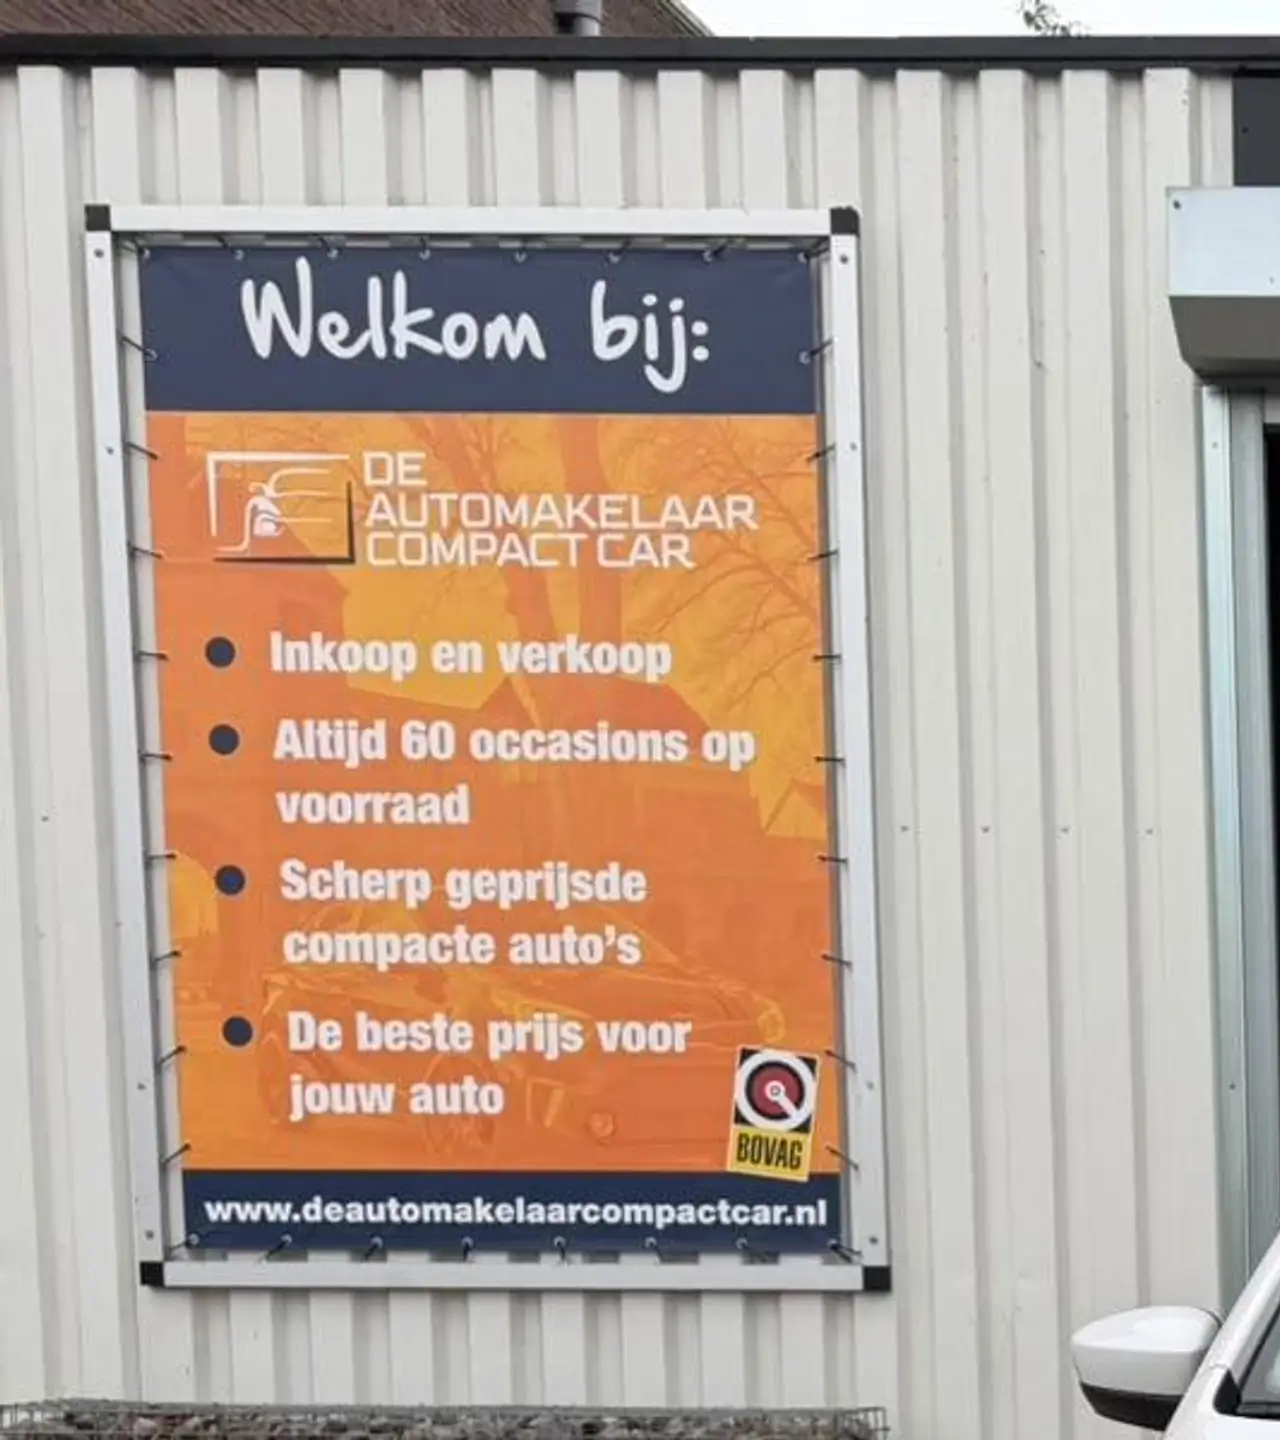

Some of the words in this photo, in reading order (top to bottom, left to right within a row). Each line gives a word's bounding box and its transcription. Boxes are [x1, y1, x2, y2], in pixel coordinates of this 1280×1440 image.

[241, 256, 546, 360] Welkom
[591, 281, 710, 392] bij:
[363, 452, 427, 486] DE
[364, 493, 759, 531] AUTOMAKELAAR
[366, 532, 580, 568] COMPACT
[595, 533, 696, 568] CAR
[269, 631, 418, 681] Inkoop
[432, 638, 483, 675] en
[496, 632, 672, 681] verkoop
[273, 718, 387, 770] Altijd
[400, 719, 454, 761] 60
[469, 719, 689, 762] occasions
[701, 727, 757, 771] op
[275, 783, 470, 825] voorraad
[280, 859, 431, 911] Scherp
[445, 861, 648, 911] geprijsde
[282, 925, 496, 974] compacte
[508, 925, 643, 967] auto's
[287, 1011, 343, 1053] De
[355, 1011, 473, 1053] beste
[487, 1015, 584, 1063] prijs
[595, 1017, 693, 1053] voor
[289, 1075, 395, 1125] jouw
[408, 1077, 505, 1117] auto
[736, 1132, 804, 1171] BOVAG
[203, 1195, 829, 1228] www.deautomakelaarcompactcar.nl
